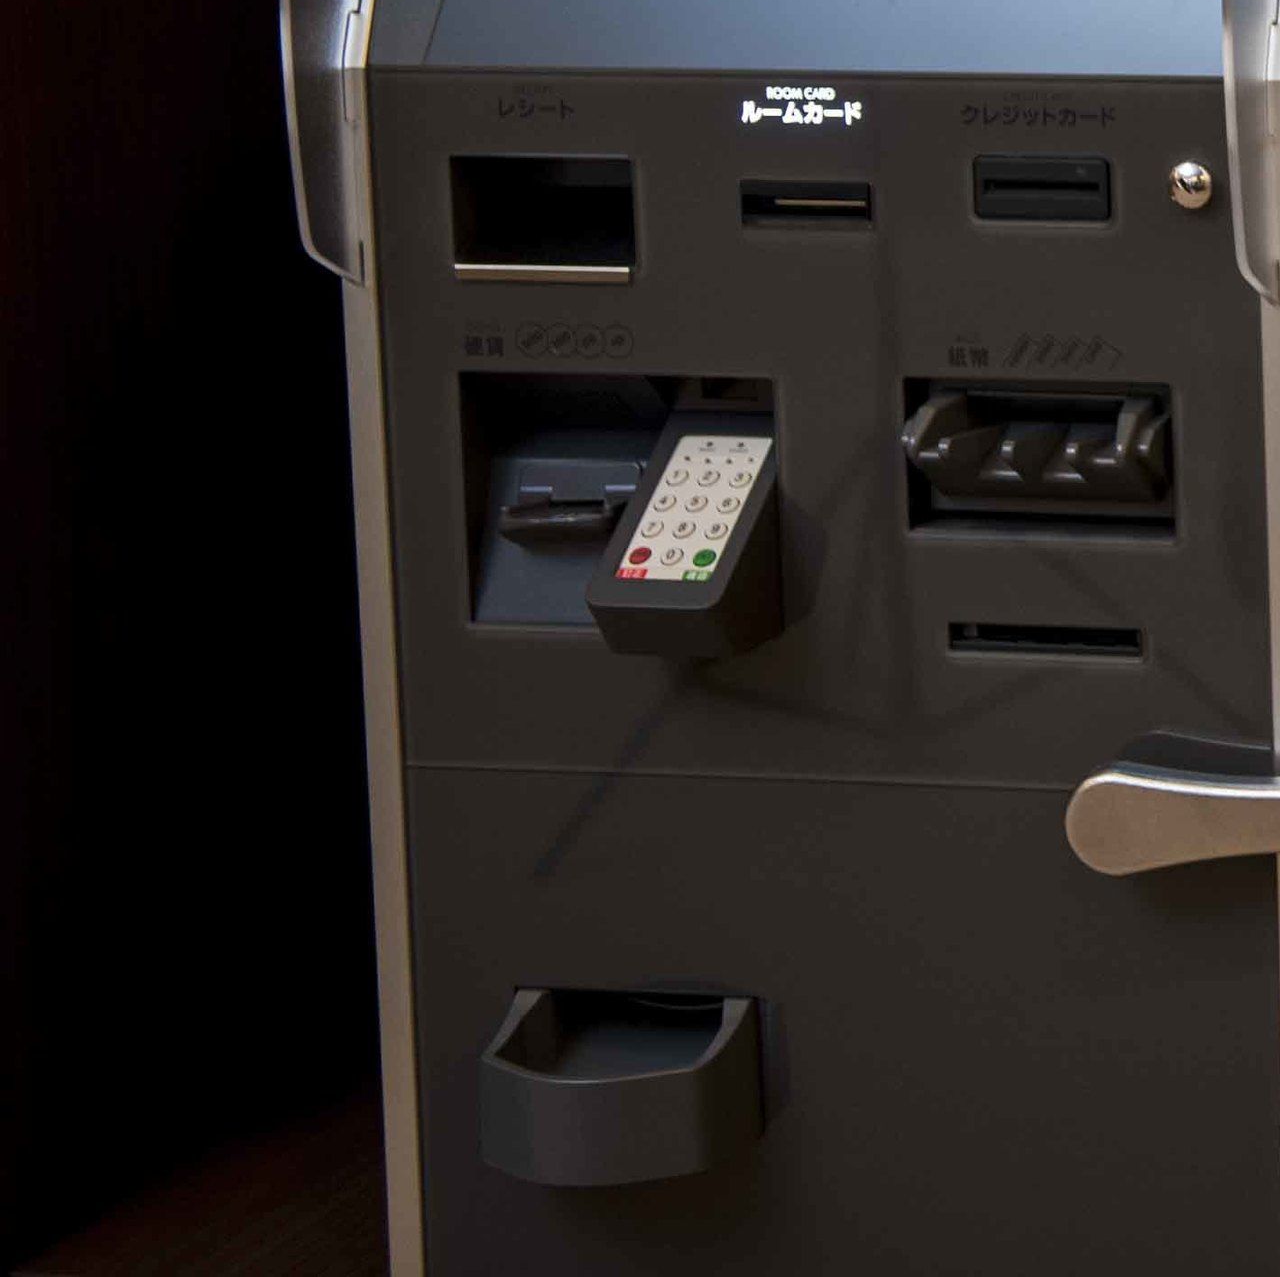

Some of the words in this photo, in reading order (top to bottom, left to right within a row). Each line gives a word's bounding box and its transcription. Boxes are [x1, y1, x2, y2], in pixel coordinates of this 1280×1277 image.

[766, 86, 803, 100] ROOM
[803, 87, 836, 101] CARD
[498, 97, 575, 119] レシート
[741, 100, 862, 125] ルームカード
[960, 104, 1116, 128] クレジットカード
